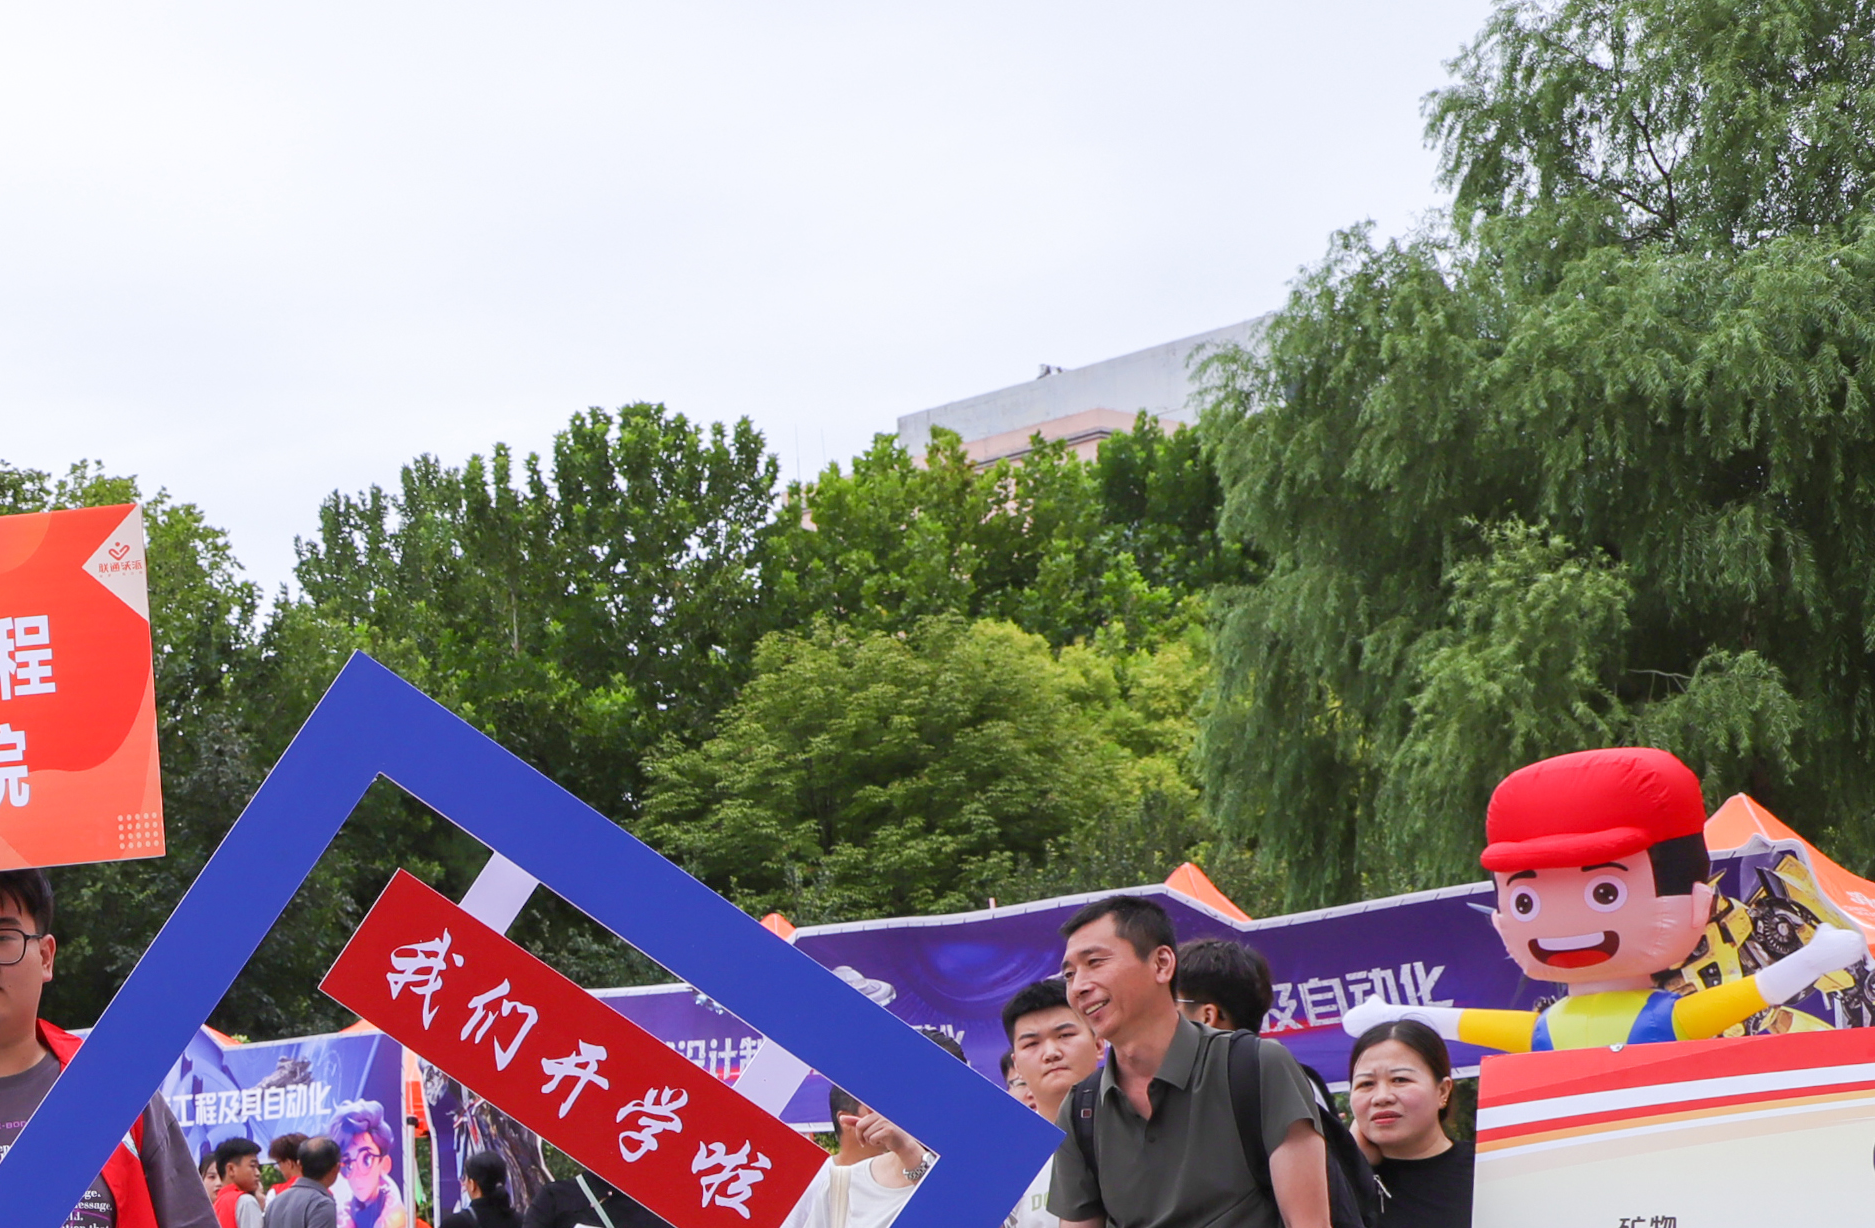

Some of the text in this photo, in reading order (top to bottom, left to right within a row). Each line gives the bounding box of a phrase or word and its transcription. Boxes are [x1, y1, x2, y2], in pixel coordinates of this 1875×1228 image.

[387, 929, 772, 1219] 我们开学啦
[168, 1081, 332, 1127] 工程及其自动化
[75, 1201, 113, 1212] essage.
